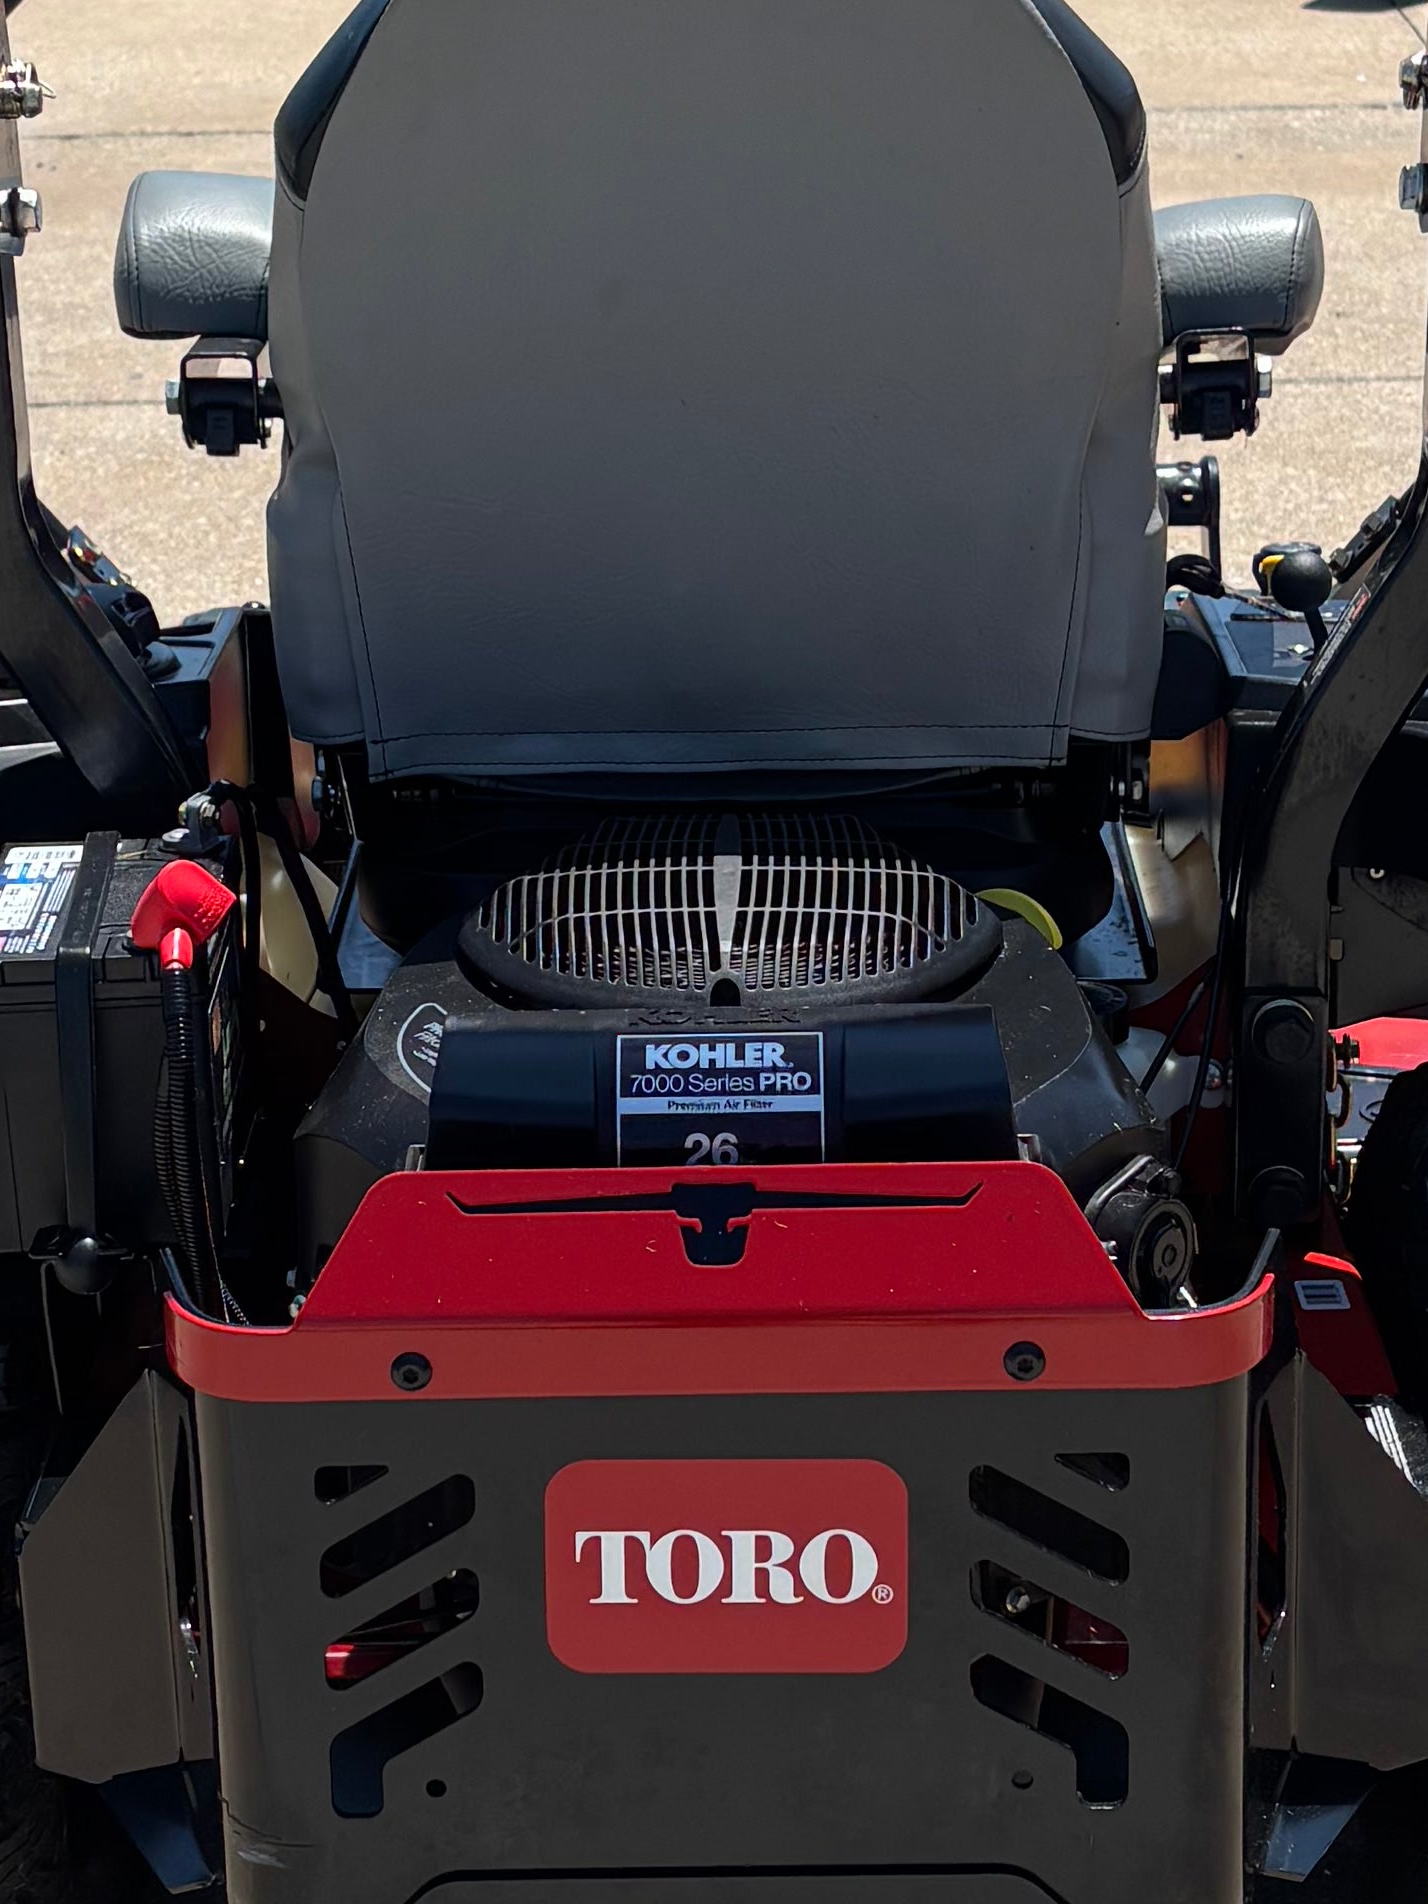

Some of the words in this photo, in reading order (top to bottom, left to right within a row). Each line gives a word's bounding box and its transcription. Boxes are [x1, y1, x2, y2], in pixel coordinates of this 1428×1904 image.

[630, 1074, 684, 1093] 7000
[688, 1072, 755, 1092] Series
[759, 1071, 812, 1092] PRO
[724, 1099, 741, 1110] Air
[684, 1132, 739, 1166] 26
